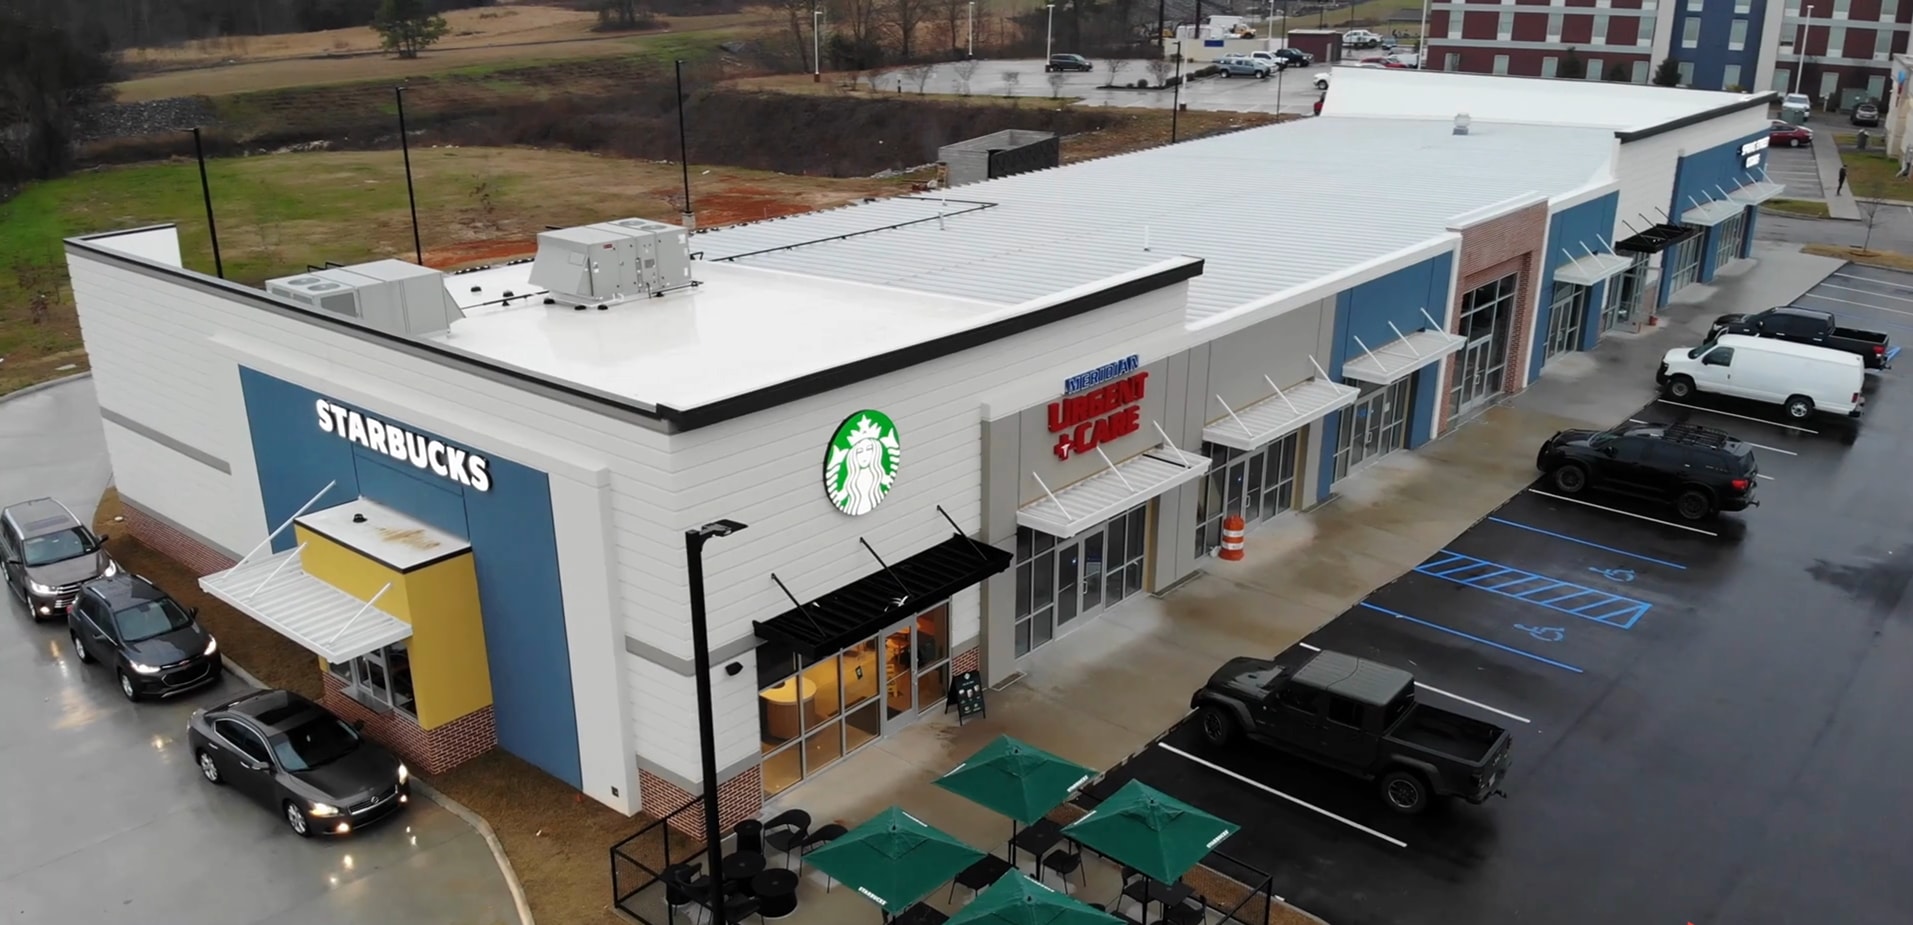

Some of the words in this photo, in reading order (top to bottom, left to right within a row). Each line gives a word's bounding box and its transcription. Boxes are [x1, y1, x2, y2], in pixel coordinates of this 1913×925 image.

[1064, 354, 1139, 394] MERIDIAN
[1048, 372, 1148, 432] URGENT
[1073, 404, 1140, 454] CARE
[315, 398, 492, 492] STARBUCKS
